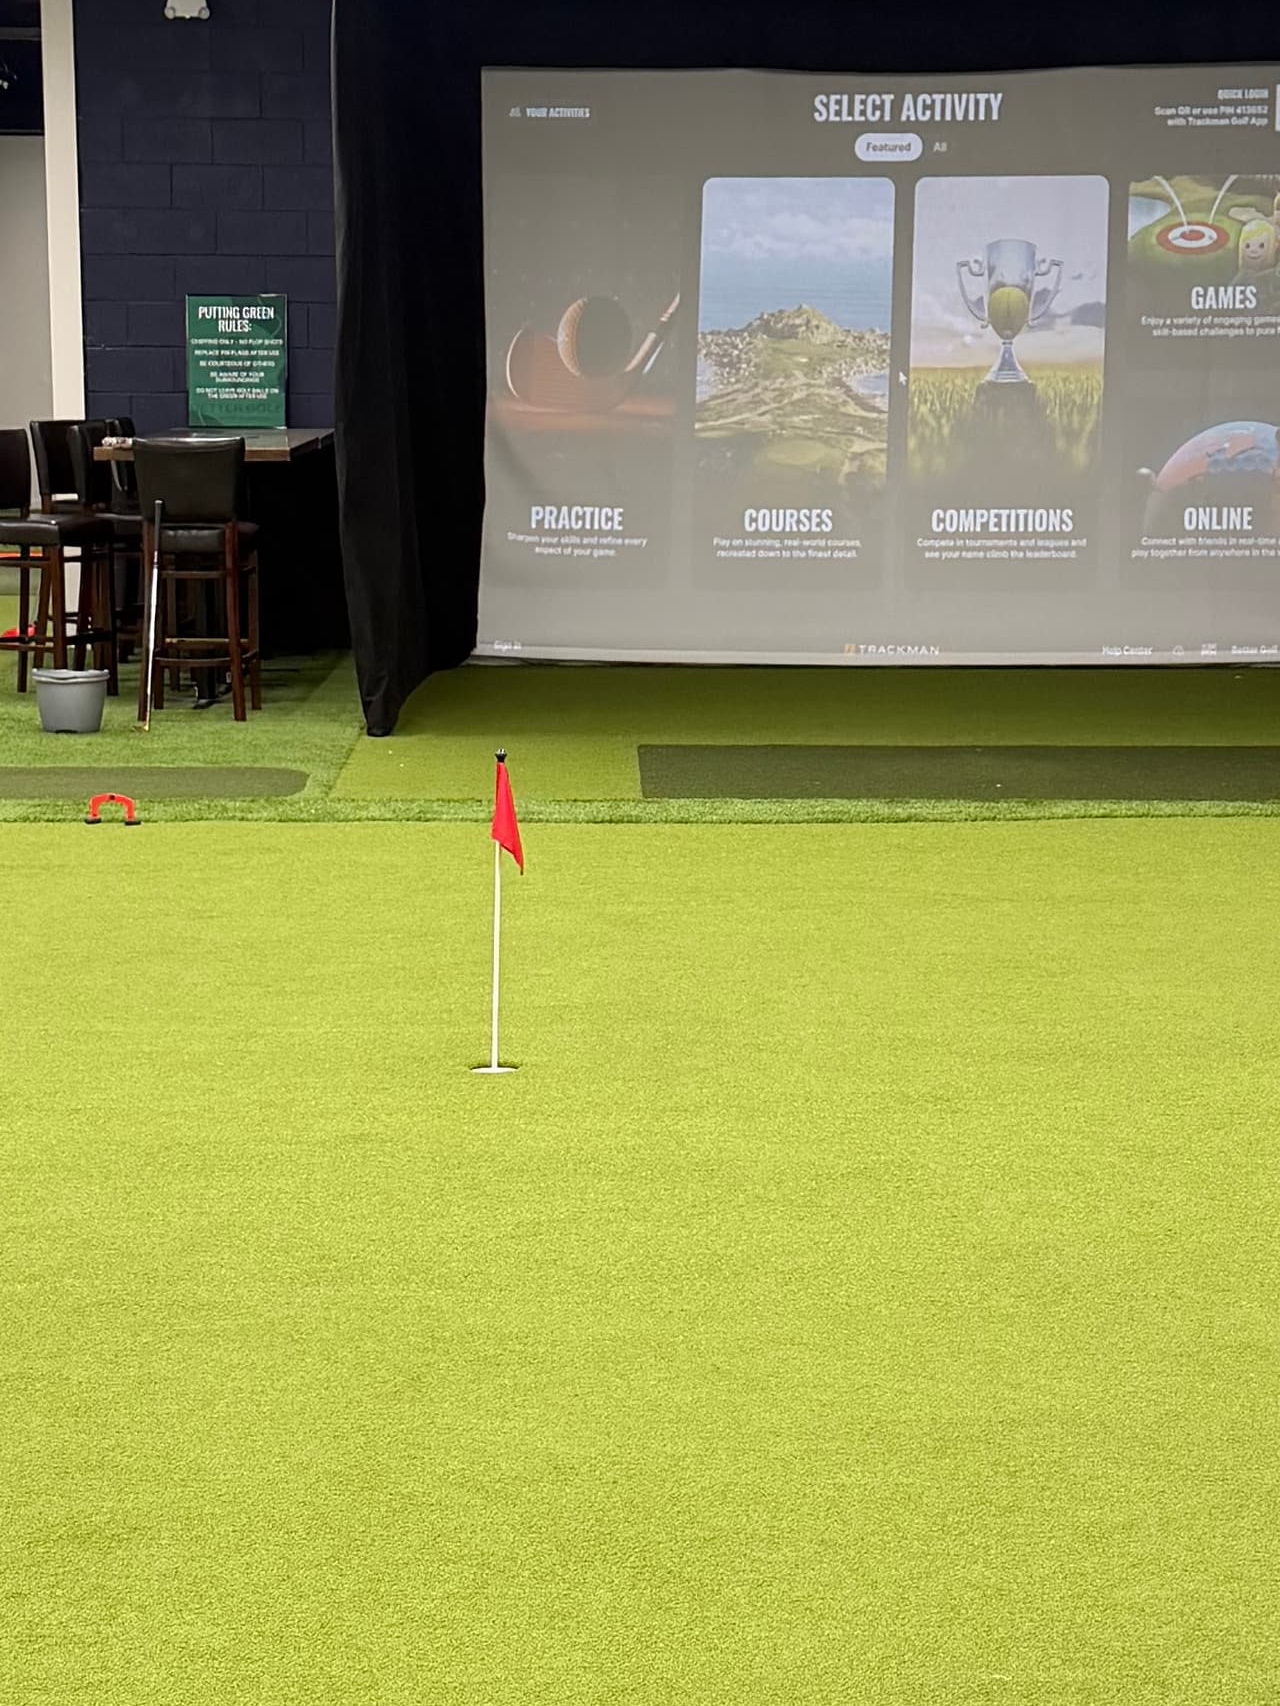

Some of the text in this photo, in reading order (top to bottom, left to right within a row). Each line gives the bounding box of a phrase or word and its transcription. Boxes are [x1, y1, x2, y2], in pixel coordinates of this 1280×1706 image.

[526, 107, 590, 117] YOUR ACTIVITIES
[813, 92, 1004, 122] SELECT ACTIVITY
[1154, 106, 1177, 116] Scan
[1177, 105, 1191, 116] QR
[1192, 107, 1201, 115] or
[1202, 107, 1218, 115] use
[1167, 116, 1268, 127] with Trackman Golf App
[866, 141, 948, 153] Featured All
[1191, 285, 1258, 310] GAMES
[198, 306, 275, 320] PUTTING GREEN
[218, 320, 252, 332] RULES:
[1141, 315, 1165, 327] Enjoy
[1172, 315, 1202, 326] variety
[1202, 314, 1213, 324] of
[1213, 316, 1252, 326] engaging
[1199, 326, 1245, 338] challenges
[1246, 327, 1255, 336] to
[1256, 328, 1276, 337] pure
[530, 505, 624, 531] PRACTICE
[744, 508, 833, 532] COURSES
[931, 508, 1074, 533] COMPETITIONS
[1183, 506, 1253, 531] ONLINE
[541, 536, 559, 545] your
[560, 535, 581, 544] skills
[582, 536, 599, 545] and
[599, 536, 623, 545] refine
[624, 538, 648, 548] every
[713, 537, 731, 548] Play
[732, 539, 744, 547] on
[917, 538, 954, 548] Compete
[955, 538, 965, 547] in
[966, 538, 1018, 547] tournaments
[1019, 538, 1035, 547] and
[1071, 538, 1087, 547] and
[1141, 537, 1177, 546] Connect
[1178, 537, 1197, 546] with
[1198, 536, 1227, 546] friends
[1229, 537, 1237, 546] in
[563, 546, 572, 555] of
[573, 548, 592, 557] your
[717, 549, 756, 558] recreated
[757, 549, 781, 558] down
[782, 549, 790, 558] to
[791, 549, 806, 558] the
[807, 549, 832, 558] finest
[925, 551, 940, 559] see
[941, 551, 960, 560] your
[961, 551, 985, 559] name
[986, 549, 1009, 559] climb
[1010, 549, 1024, 558] the
[1131, 549, 1149, 559] play
[1150, 549, 1187, 560] together
[1188, 549, 1208, 558] from
[1209, 549, 1250, 559] anywhere
[1251, 549, 1260, 558] in
[1261, 549, 1276, 558] the
[858, 644, 940, 656] TRACKMAN
